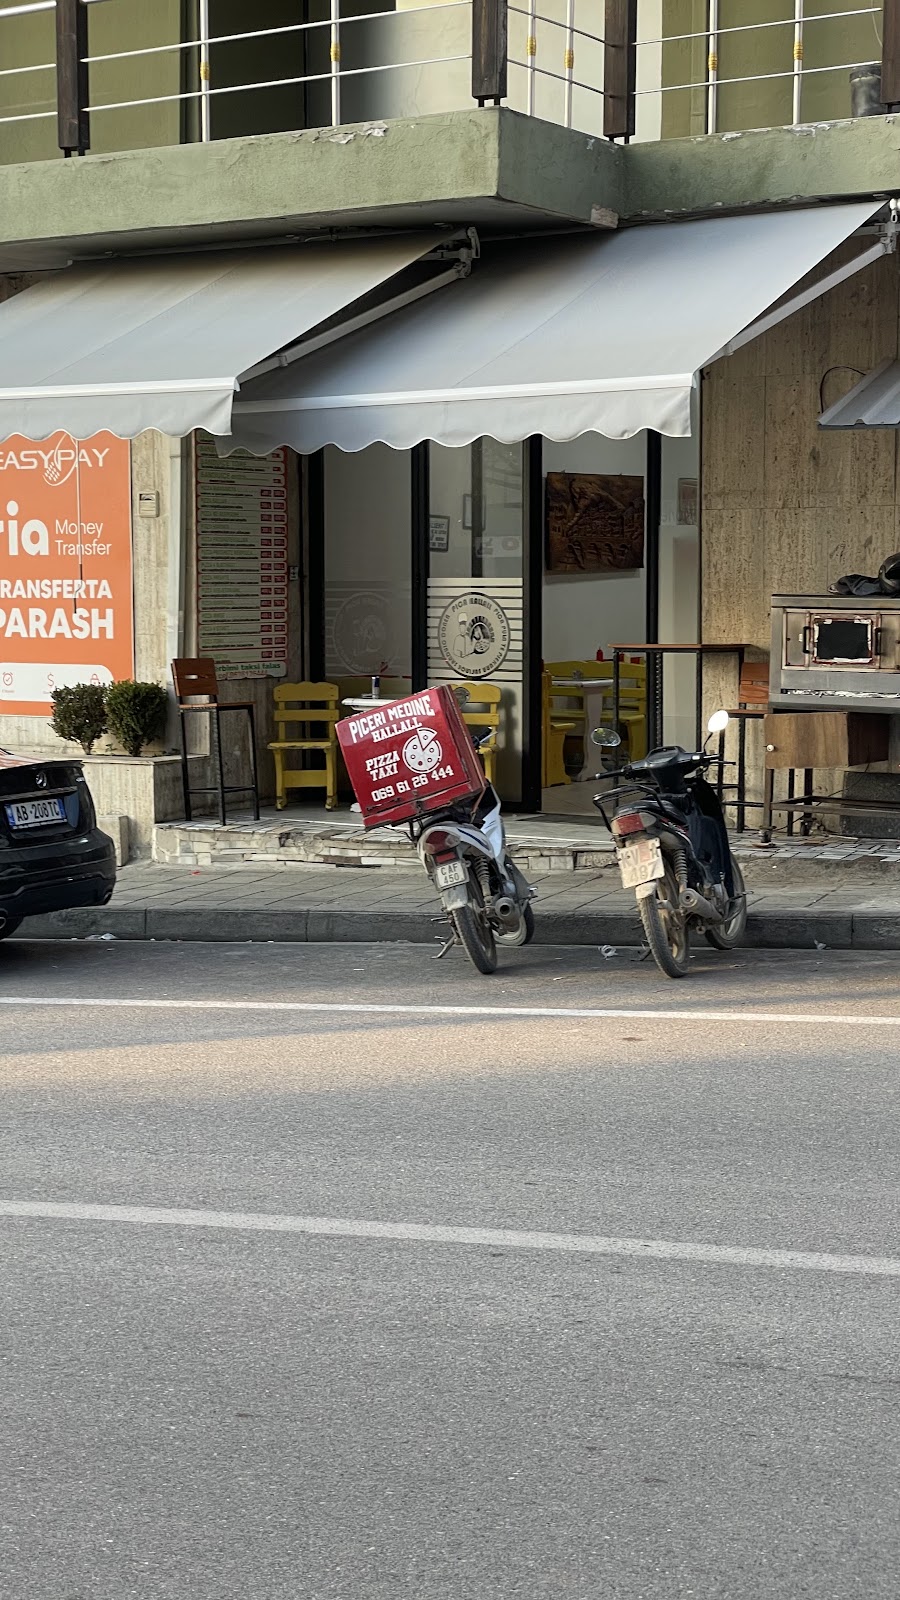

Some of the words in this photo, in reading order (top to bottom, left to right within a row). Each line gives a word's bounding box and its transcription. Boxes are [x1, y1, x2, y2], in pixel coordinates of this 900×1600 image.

[0, 500, 49, 556] ia
[55, 519, 104, 538] Money
[55, 538, 112, 555] Transfer
[0, 579, 113, 599] RANSFERTA
[348, 711, 385, 743] PICERI
[387, 695, 435, 722] MEDINE
[371, 717, 422, 743] HALLALL
[365, 751, 400, 772] PIZZA
[370, 763, 399, 782] TAXI
[371, 785, 395, 802] 069
[396, 780, 411, 793] 61
[412, 773, 428, 787] 26
[431, 765, 454, 781] 444
[16, 805, 28, 822] AB
[32, 802, 49, 820] 208
[48, 801, 60, 817] TC
[443, 873, 460, 884] 450
